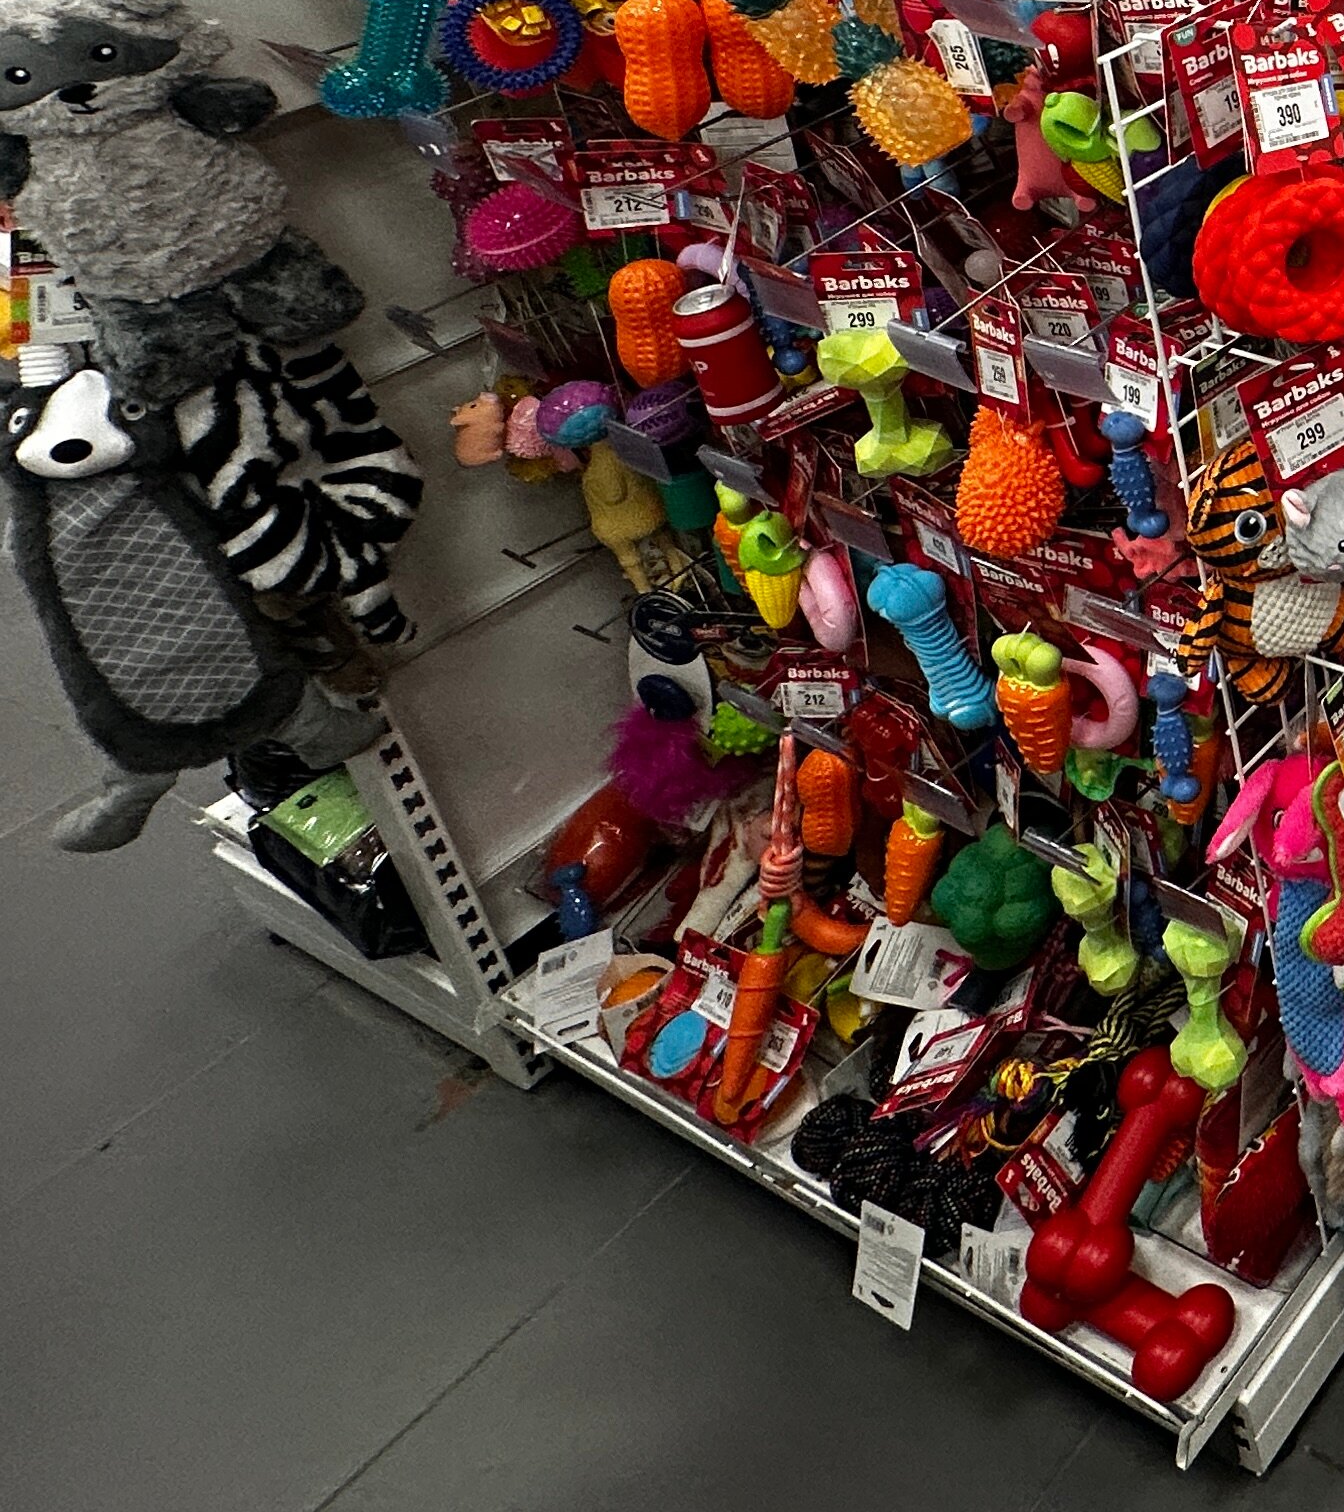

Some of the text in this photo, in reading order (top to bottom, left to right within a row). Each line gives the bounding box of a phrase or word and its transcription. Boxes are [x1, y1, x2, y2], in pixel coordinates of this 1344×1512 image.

[1174, 27, 1196, 43] FUN
[954, 45, 969, 72] 265
[1184, 46, 1231, 75] Barb
[1241, 47, 1321, 75] Barbaks
[1276, 102, 1302, 127] 390
[589, 167, 676, 183] Barbaks
[822, 273, 911, 292] Barbaks
[1021, 293, 1089, 311] Barbaks
[847, 311, 876, 329] 299
[971, 313, 1016, 348] Barbaks
[1048, 322, 1072, 338] 220
[1114, 339, 1158, 372] Barba
[1122, 383, 1142, 405] 199
[1252, 366, 1344, 420] Barbaks
[1296, 422, 1326, 451] 299
[1026, 541, 1094, 571] arbaks
[787, 667, 850, 680] Barbaks
[803, 694, 826, 706] 212
[681, 950, 730, 980] Barbaks
[1020, 1152, 1062, 1213] Barbaks
